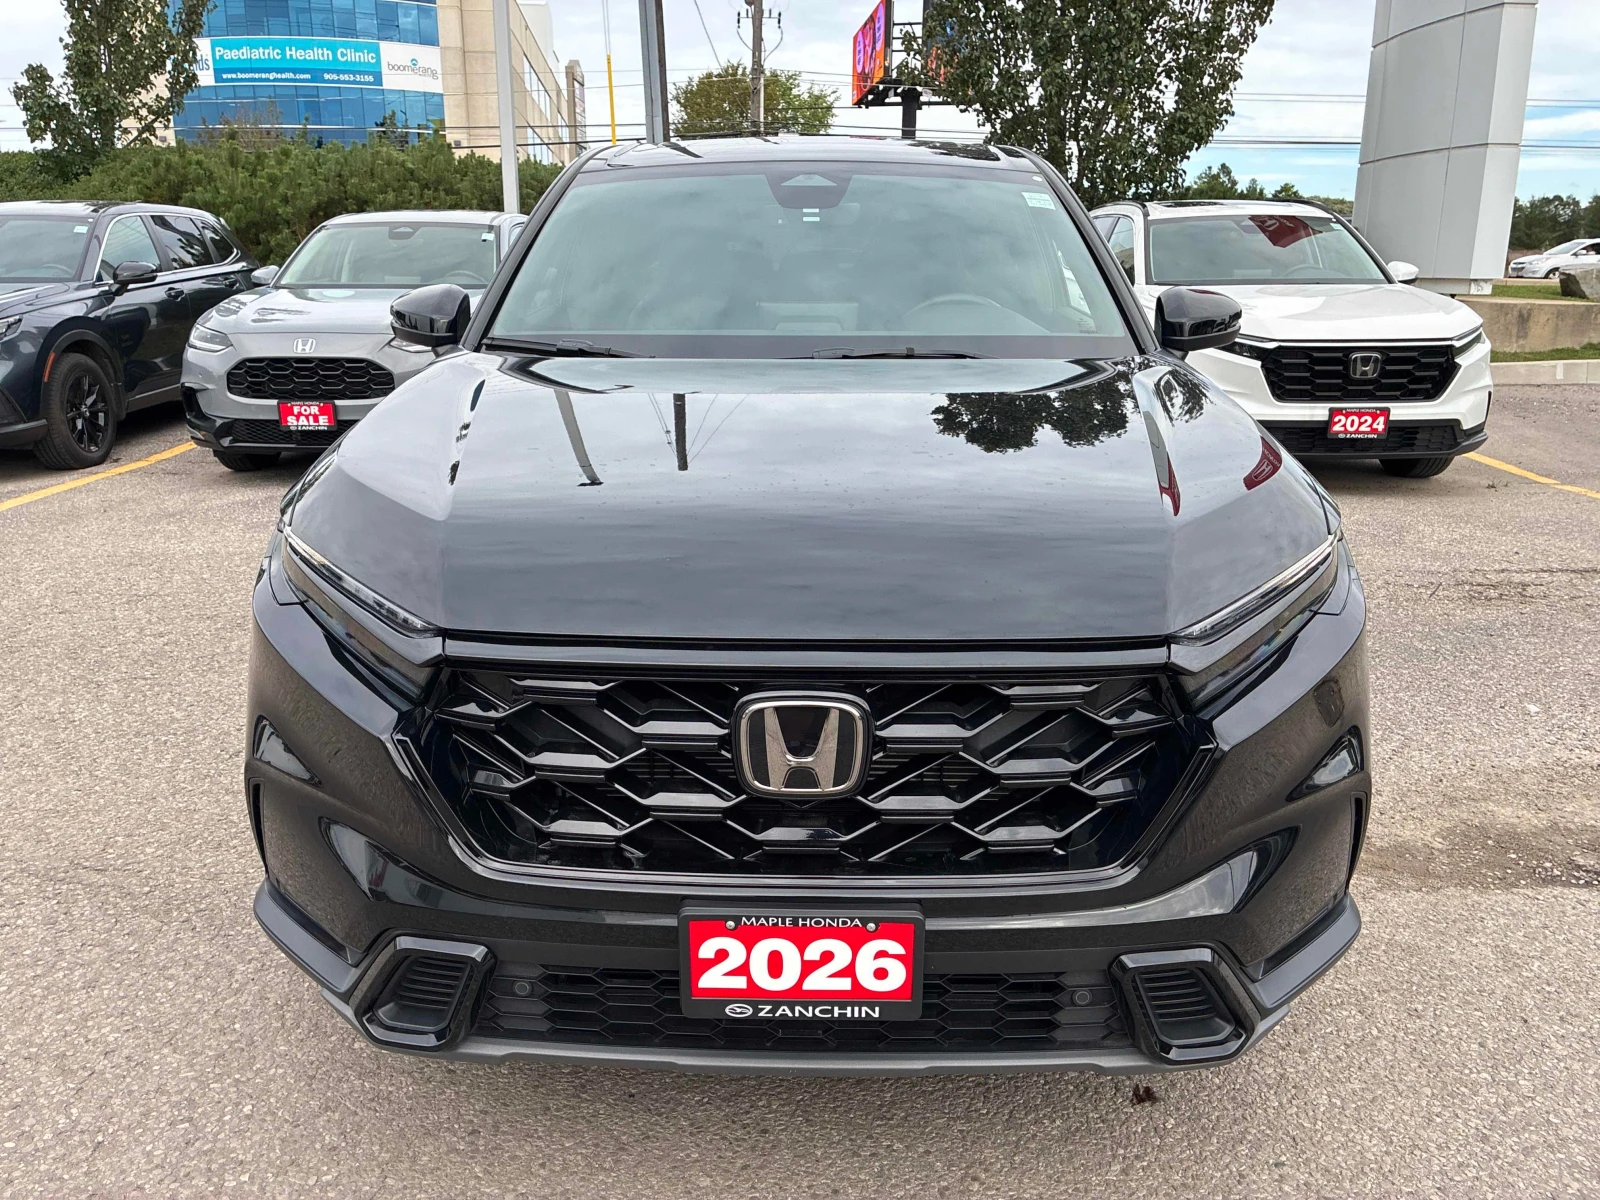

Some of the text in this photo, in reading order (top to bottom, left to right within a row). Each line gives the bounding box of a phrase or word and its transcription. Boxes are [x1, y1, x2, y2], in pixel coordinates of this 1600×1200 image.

[215, 46, 377, 63] Paediatric Health Clinic
[222, 71, 312, 80] www.boomeranghealth.com
[387, 61, 439, 80] boomerang
[293, 406, 320, 415] FOR
[287, 416, 329, 426] SALE
[1332, 415, 1384, 431] 2024
[741, 916, 862, 928] MAPLE HONDA
[697, 936, 907, 992] 2026
[757, 1005, 880, 1018] ZANCHIN
